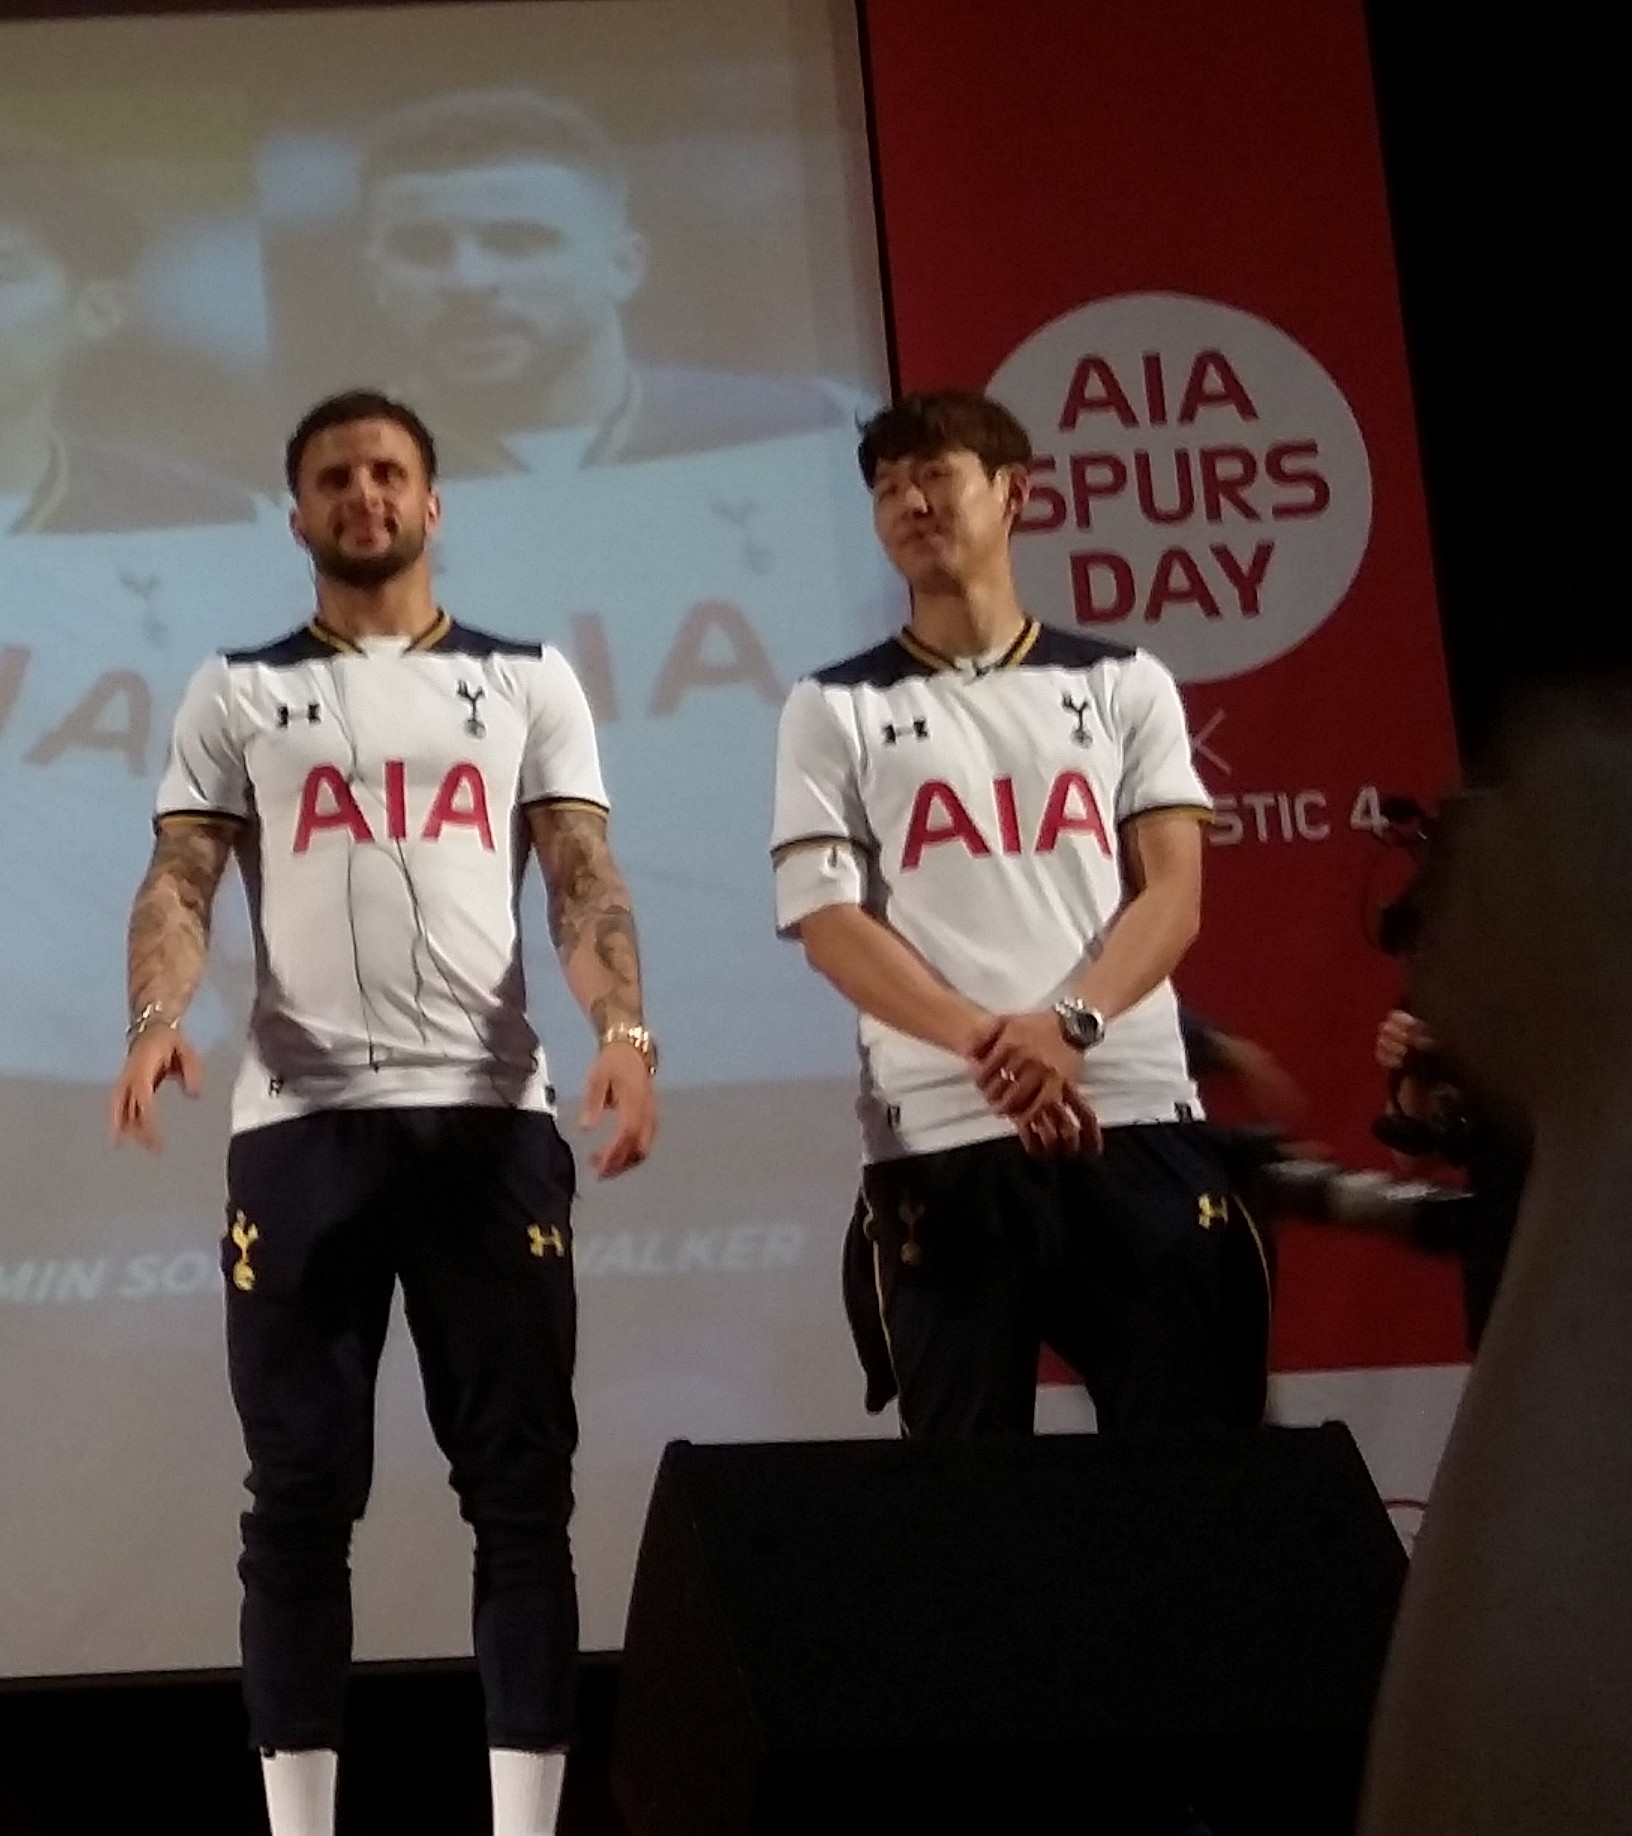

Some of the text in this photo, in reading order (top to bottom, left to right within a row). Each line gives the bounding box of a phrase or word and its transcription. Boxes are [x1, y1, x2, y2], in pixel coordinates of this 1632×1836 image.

[1059, 349, 1260, 431] AIA
[1009, 439, 1331, 533] SPURS
[1070, 540, 1275, 625] DAY
[292, 760, 496, 854] AIA
[900, 769, 1113, 871] AIA
[1349, 785, 1391, 838] 4
